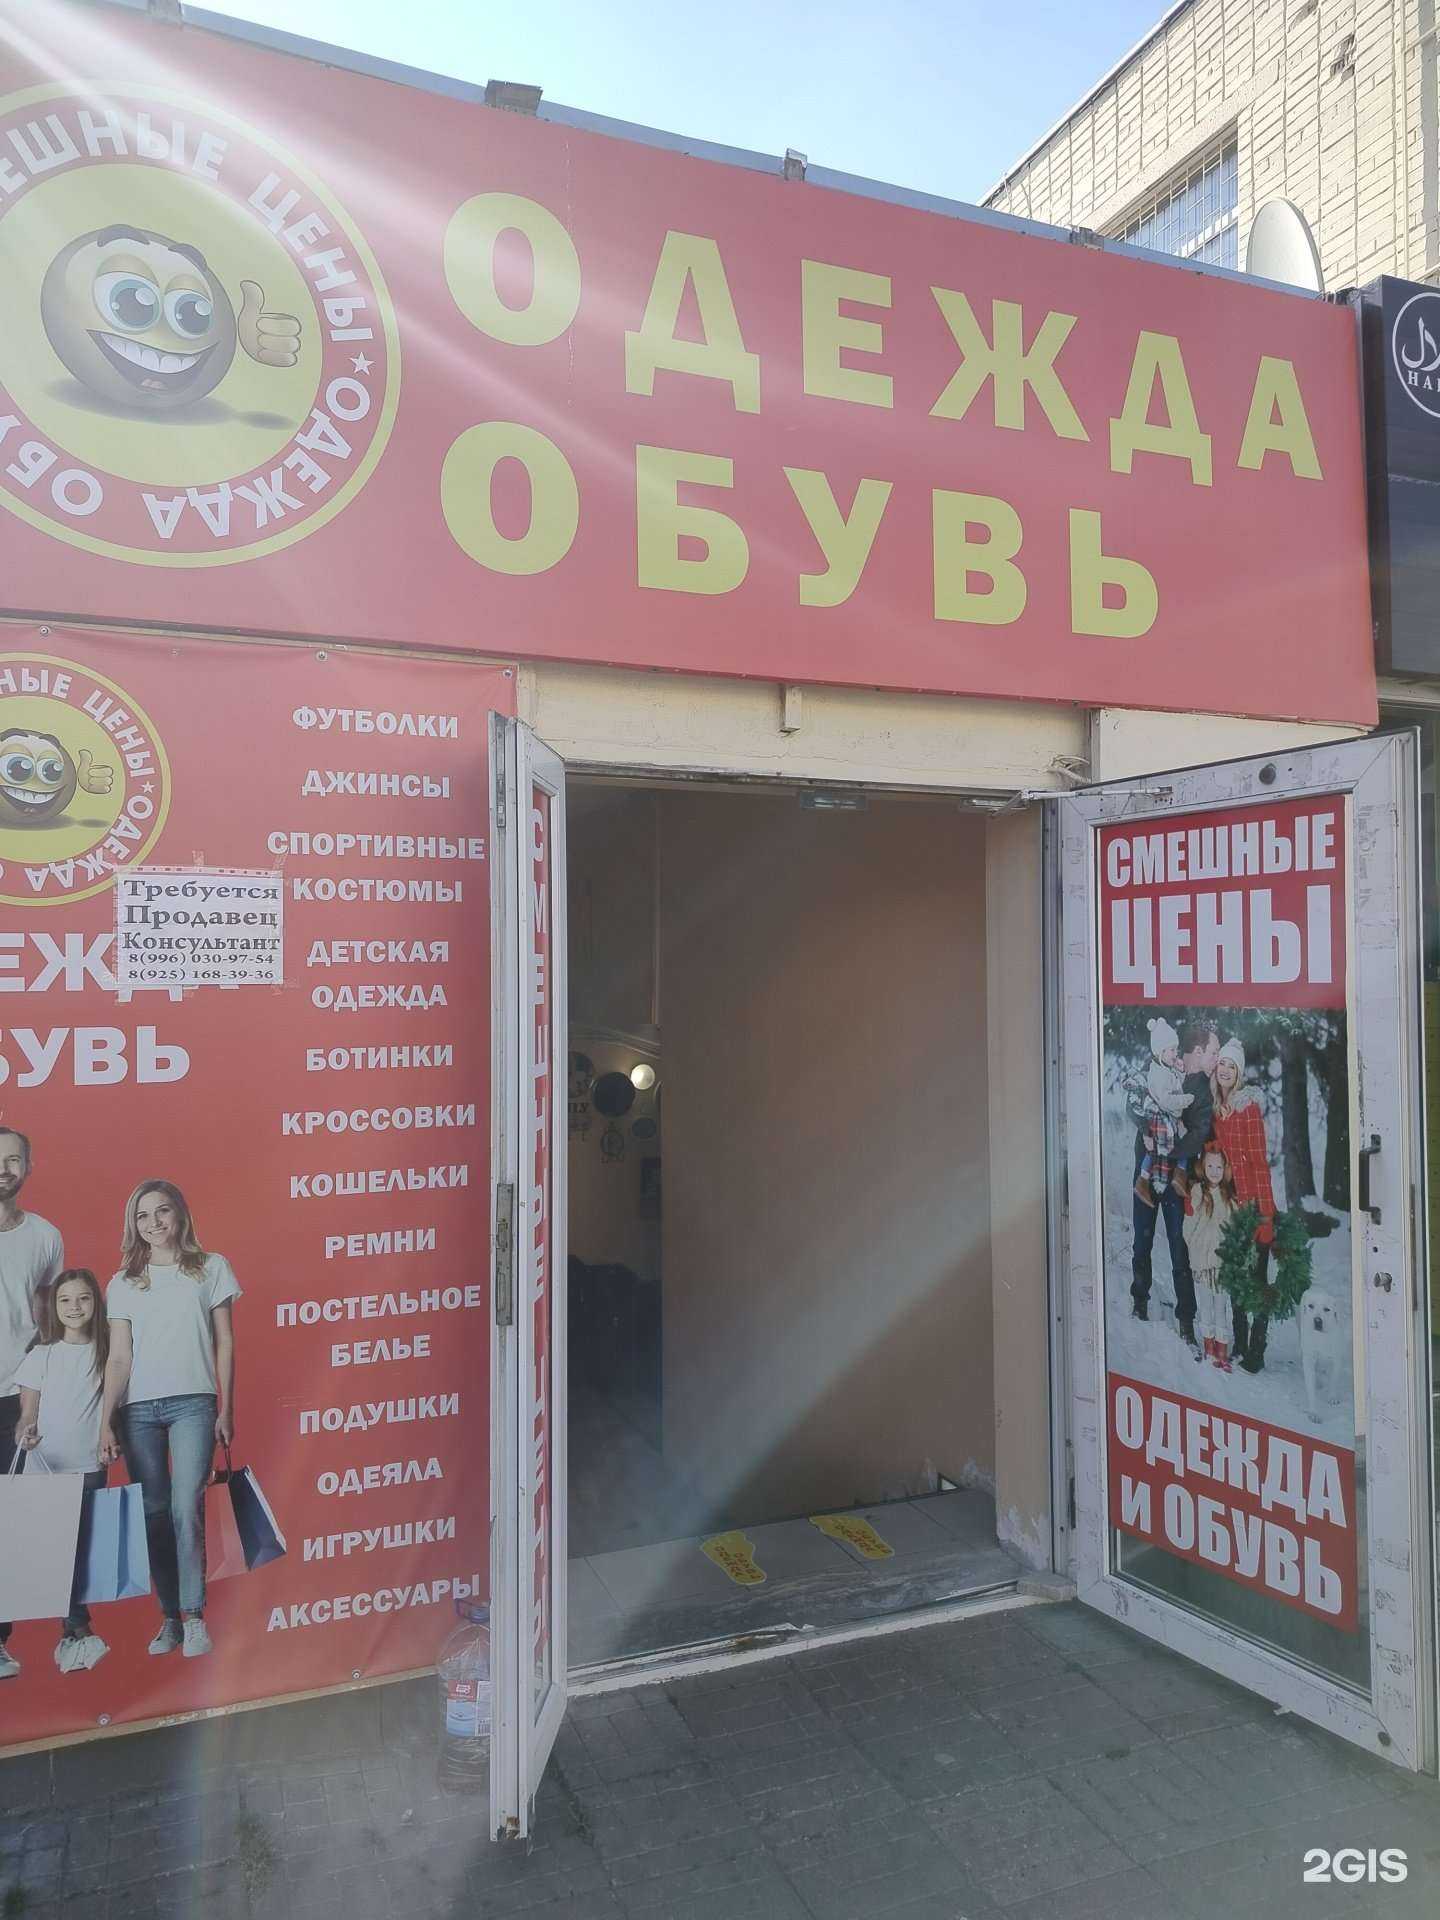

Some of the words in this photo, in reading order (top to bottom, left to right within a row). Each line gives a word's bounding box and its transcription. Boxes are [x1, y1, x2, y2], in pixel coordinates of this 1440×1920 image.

[248, 171, 374, 343] ЦЕНЫ
[444, 192, 1324, 487] ОДЕЖДА
[1408, 370, 1440, 392] HA
[142, 376, 371, 539] ОДЕЖДА
[440, 421, 1160, 639] ОБУВЬ
[83, 689, 156, 778] ЦЕНЫ
[293, 706, 459, 738] ФУТБОЛКИ
[302, 770, 450, 798] ДЖИНСЫ
[24, 795, 154, 892] ОДЕЖДА
[267, 831, 486, 860] СПОРТИВНЫЕ
[1107, 812, 1336, 888] СМЕШНЫЕ
[123, 879, 279, 902] Требуется
[293, 877, 463, 903] КОСТЮМЫ
[123, 904, 279, 930] Продавец
[121, 931, 281, 954] Консультант
[307, 941, 449, 967] ДЕТСКАЯ
[1112, 884, 1333, 999] ЦЕНЫ
[128, 953, 187, 966] 8(996)
[191, 954, 275, 965] 030-97-54
[128, 969, 186, 982] 8(925)
[192, 969, 275, 980] 168-39-36
[311, 983, 449, 1012] ОДЕЖДА
[0, 1025, 191, 1088] УВЬ
[306, 1044, 453, 1072] БОТИНКИ
[282, 1103, 476, 1136] КРОССОВКИ
[290, 1165, 468, 1199] КОШЕЛЬКИ
[325, 1228, 436, 1259] РЕМНИ
[276, 1284, 481, 1328] ПОСТЕЛЬНОЕ
[331, 1334, 431, 1367] БЕЛЬЕ
[300, 1392, 459, 1435] ПОДУШКИ
[1115, 1385, 1347, 1529] ОДЕЖДА
[317, 1457, 444, 1497] ОДЕЯЛА
[303, 1516, 456, 1562] ИГРУШКИ
[1121, 1474, 1152, 1535] И
[1163, 1484, 1342, 1616] ОБУВЬ
[267, 1573, 480, 1632] АКСЕССУАРЫ
